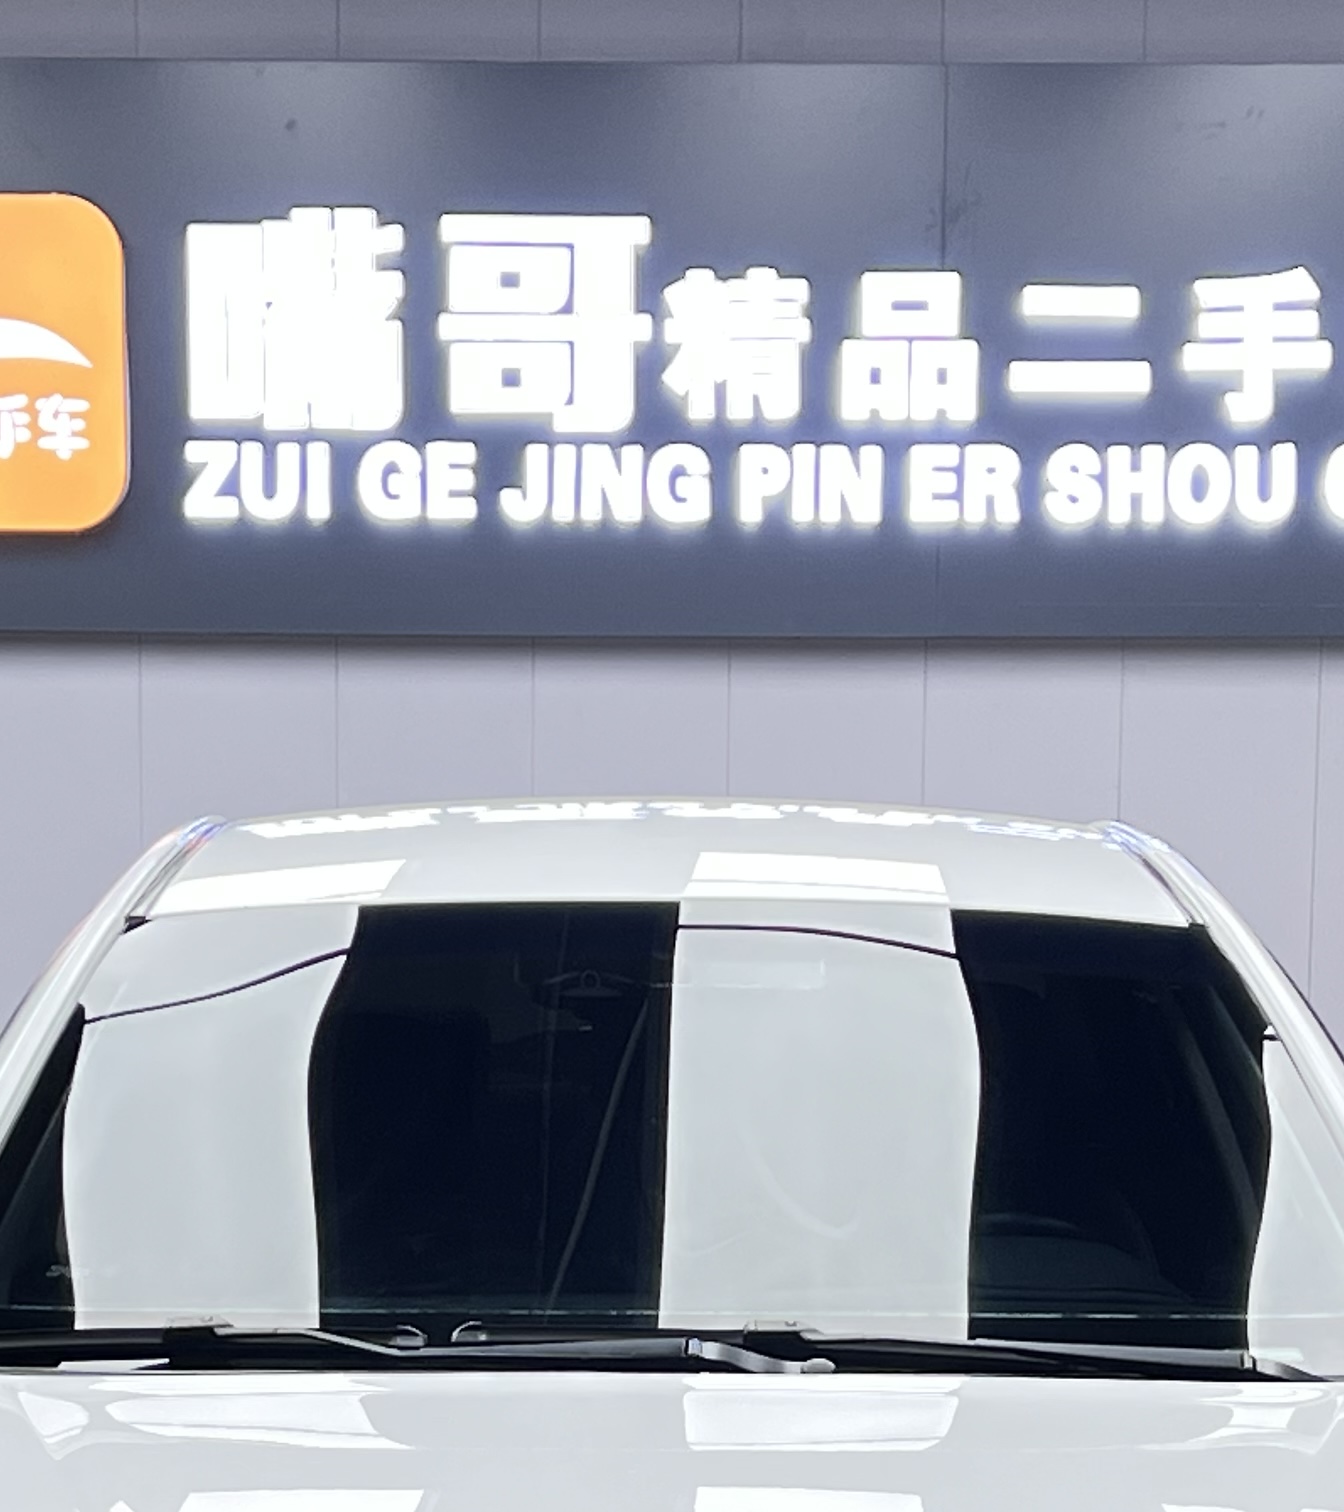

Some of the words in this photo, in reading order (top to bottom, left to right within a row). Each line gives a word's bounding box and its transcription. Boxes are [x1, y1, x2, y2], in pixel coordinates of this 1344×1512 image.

[184, 440, 331, 521] ZUI
[357, 440, 478, 521] GE
[500, 442, 712, 523] JING
[738, 443, 883, 524] PIN
[908, 443, 1021, 524] ER
[1045, 442, 1297, 524] SHOU
